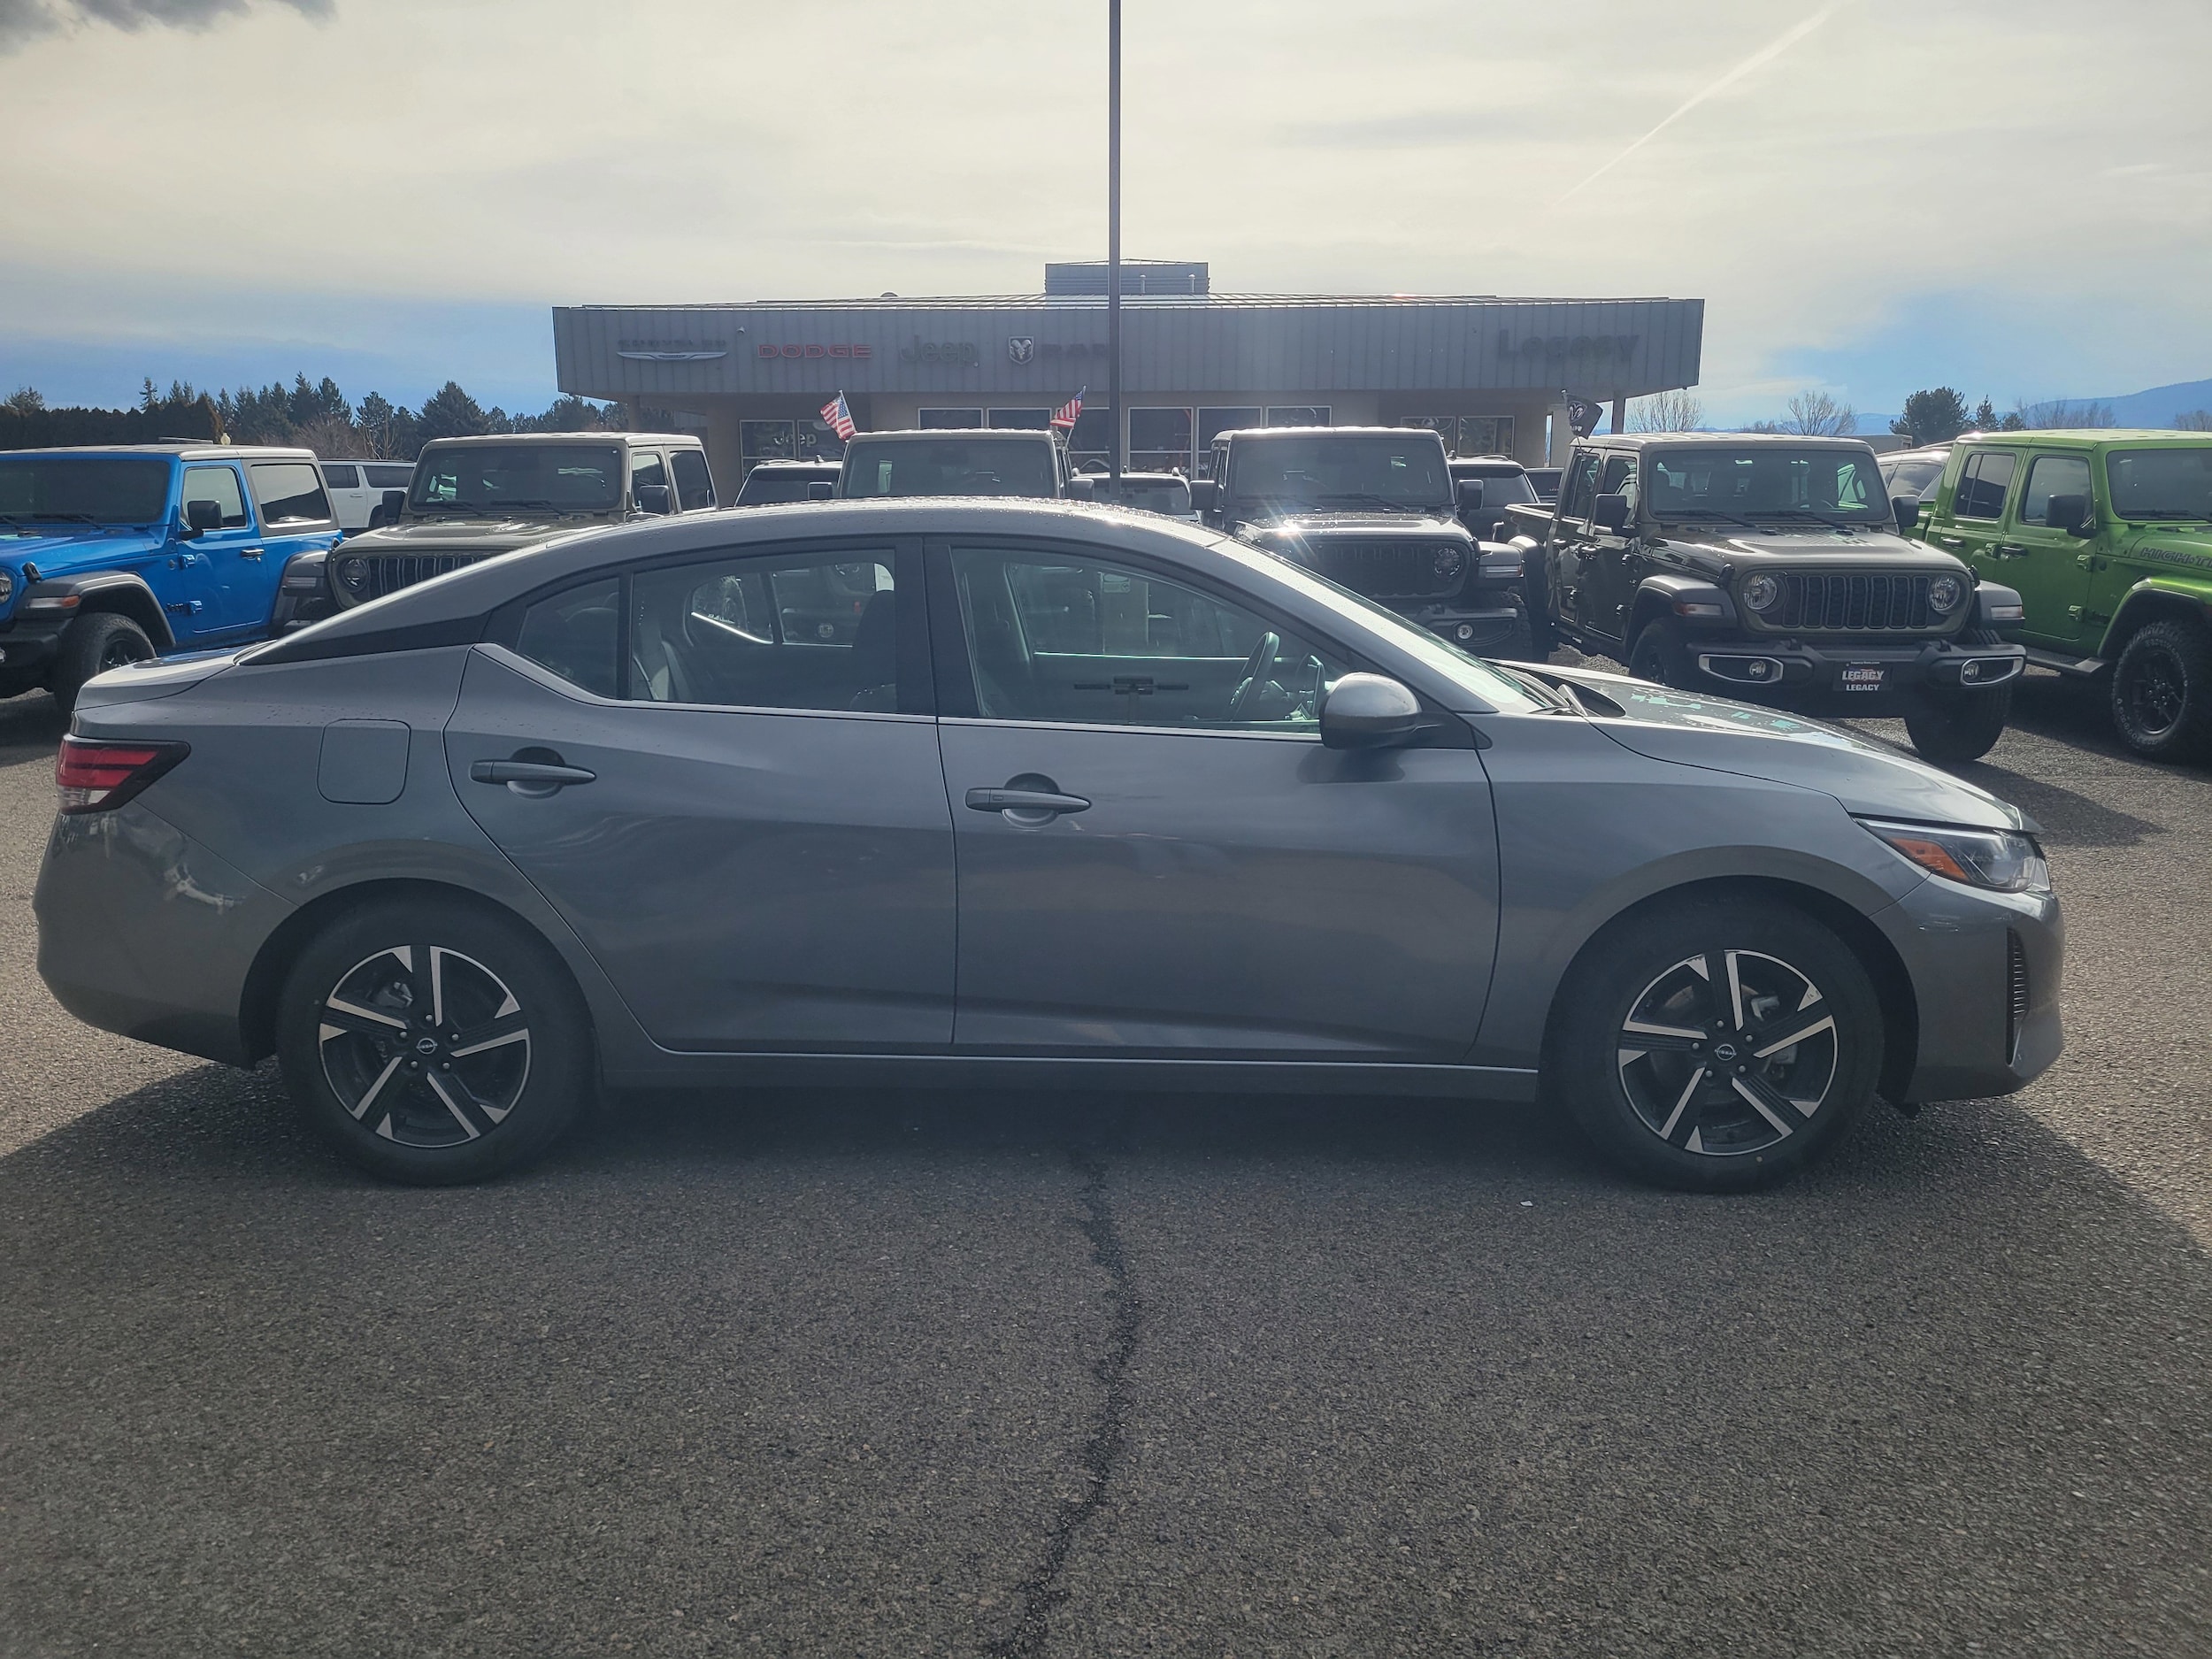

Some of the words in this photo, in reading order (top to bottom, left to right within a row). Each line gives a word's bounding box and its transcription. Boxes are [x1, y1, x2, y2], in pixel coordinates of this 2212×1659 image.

[757, 343, 872, 358] DODGE
[901, 334, 979, 367] Jeep
[2140, 547, 2191, 564] HIGH
[1842, 670, 1884, 680] LEGACY
